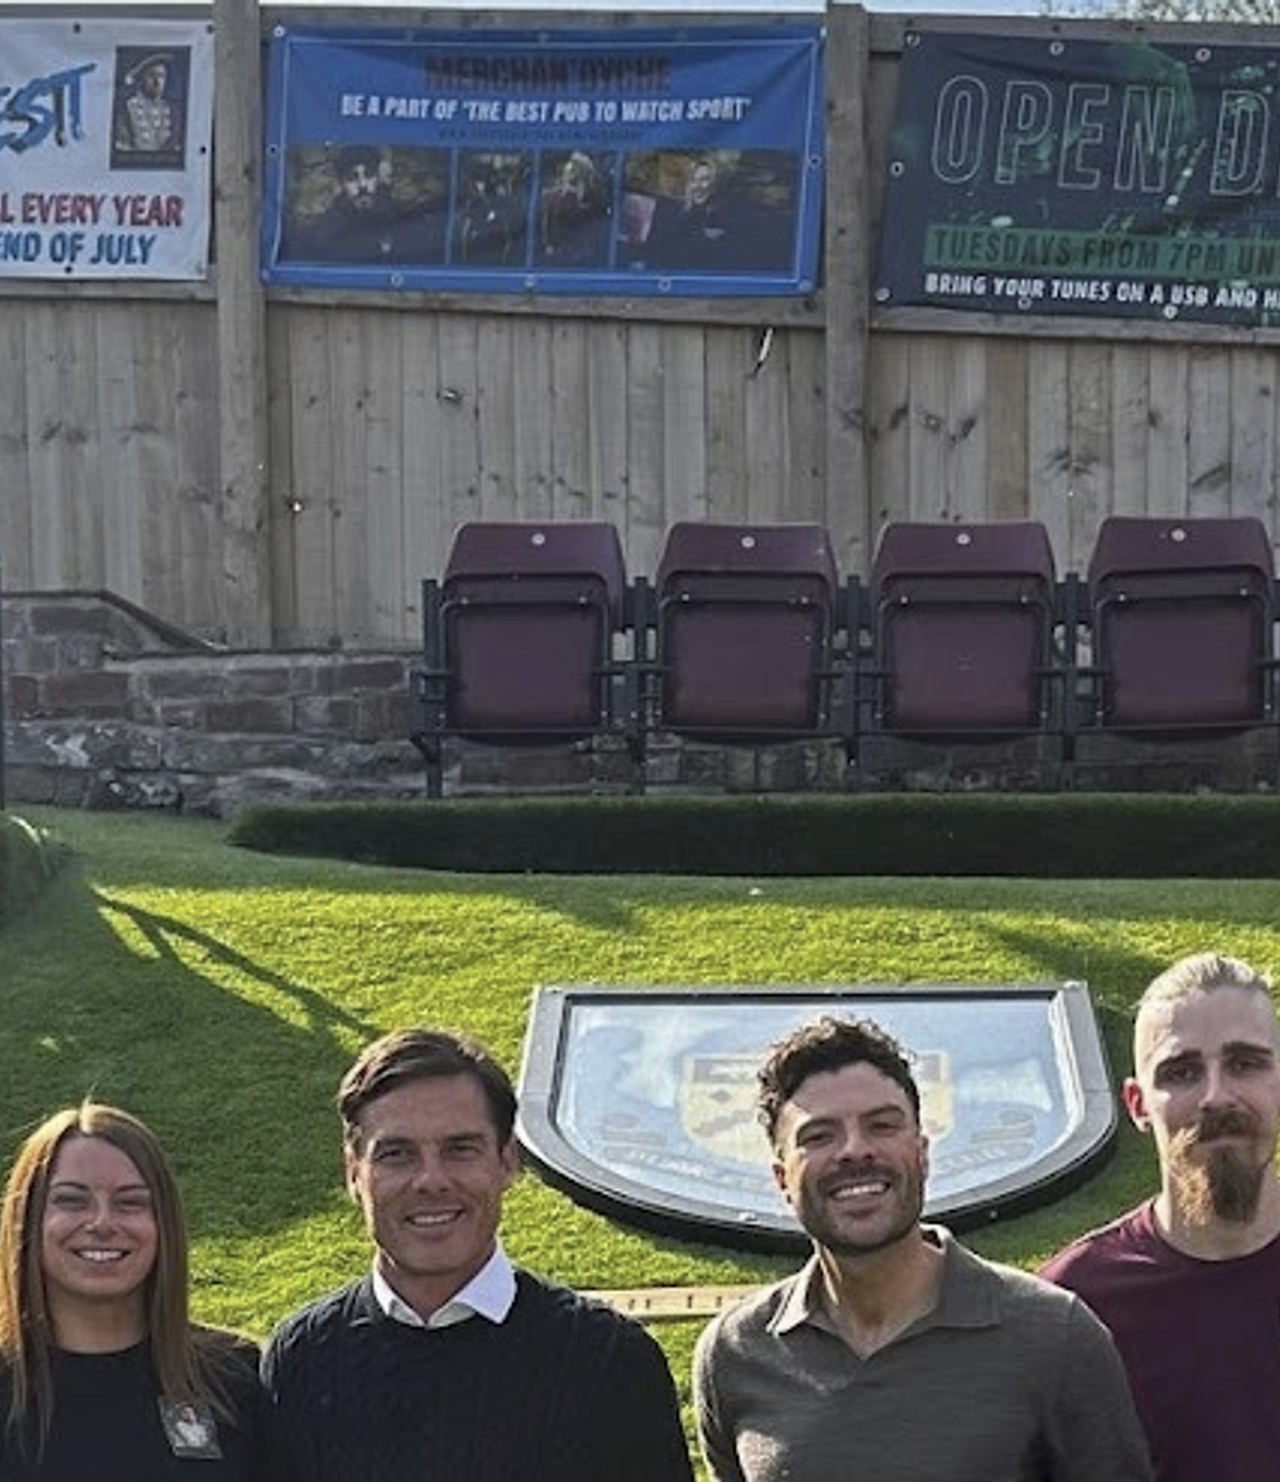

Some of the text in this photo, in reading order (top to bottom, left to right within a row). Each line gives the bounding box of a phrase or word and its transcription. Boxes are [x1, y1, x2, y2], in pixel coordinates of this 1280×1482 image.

[341, 94, 366, 116] BE
[367, 96, 381, 116] A
[384, 97, 432, 119] PART
[434, 99, 460, 121] OF
[505, 101, 550, 122] BEST
[553, 101, 591, 122] PUB
[595, 101, 619, 122] TO
[622, 100, 685, 122] WATCH
[932, 75, 1176, 194] OPEN
[21, 193, 105, 225] EVERY
[113, 194, 186, 227] YEAR
[48, 231, 87, 263] OF
[89, 233, 157, 265] JULY
[931, 228, 1073, 267] TUESDAYS
[1083, 236, 1160, 270] FROM
[1168, 242, 1227, 272] 7PM
[925, 272, 988, 295] BRING
[993, 277, 1046, 299] YOUR
[1050, 279, 1113, 302] TUNES
[1117, 281, 1147, 304] ON
[1150, 283, 1165, 304] A
[1171, 284, 1210, 306] USB
[1216, 286, 1258, 308] AND
